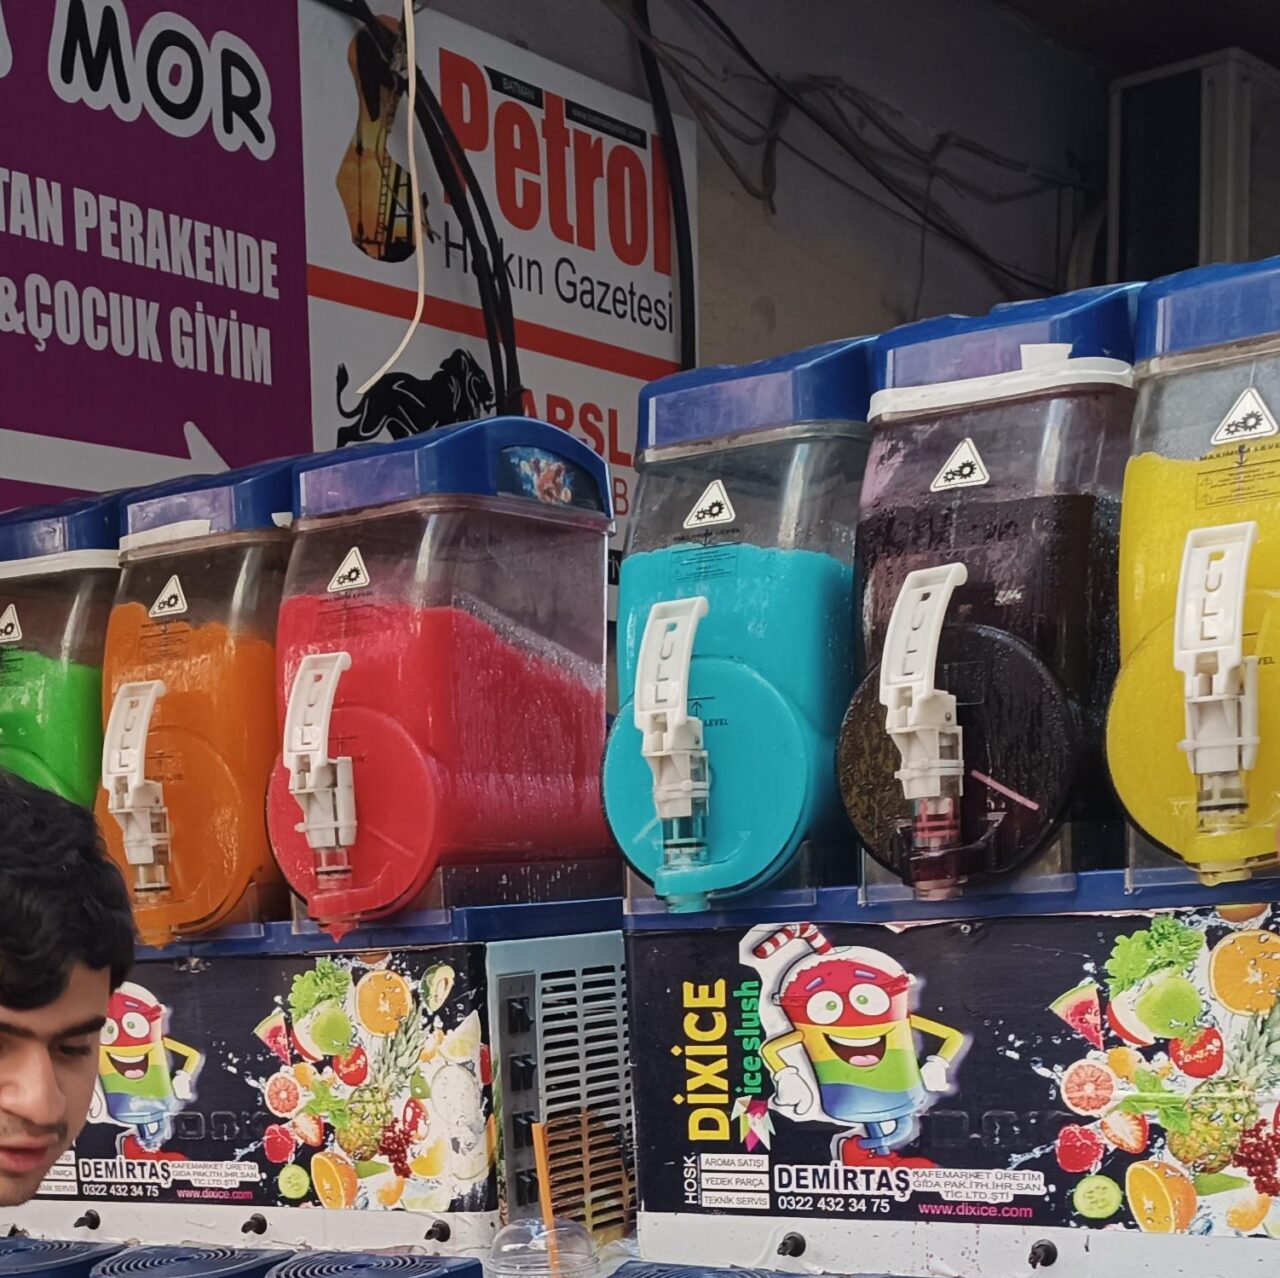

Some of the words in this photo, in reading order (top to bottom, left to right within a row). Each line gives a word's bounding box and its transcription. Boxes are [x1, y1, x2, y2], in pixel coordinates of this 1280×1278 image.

[54, 0, 271, 155] MOR
[439, 47, 672, 277] Petrol
[73, 189, 280, 301] PERAKENDE
[444, 221, 544, 295] Hkın
[555, 257, 674, 333] Gazetesi
[170, 296, 273, 386] GİYİM
[671, 978, 731, 1141] DİXİCE
[81, 1157, 171, 1185] DEMİRTAŞ
[704, 1158, 736, 1168] AROMA
[912, 1170, 992, 1180] KAFEMARKET
[994, 1171, 1041, 1181] ÜRETİM
[82, 1184, 109, 1196] 0322
[109, 1184, 129, 1197] 432
[130, 1185, 144, 1197] 34
[145, 1185, 159, 1198] 75
[176, 1188, 253, 1200] www.dixice.com
[704, 1177, 734, 1186] YEDEK
[735, 1177, 765, 1188] PARÇA
[777, 1163, 910, 1199] DEMİRTAŞ
[778, 1196, 813, 1210] 0322
[816, 1197, 847, 1211] 432
[848, 1198, 867, 1212] 34
[871, 1199, 891, 1213] 75
[918, 1203, 1033, 1218] www.dixice.com
